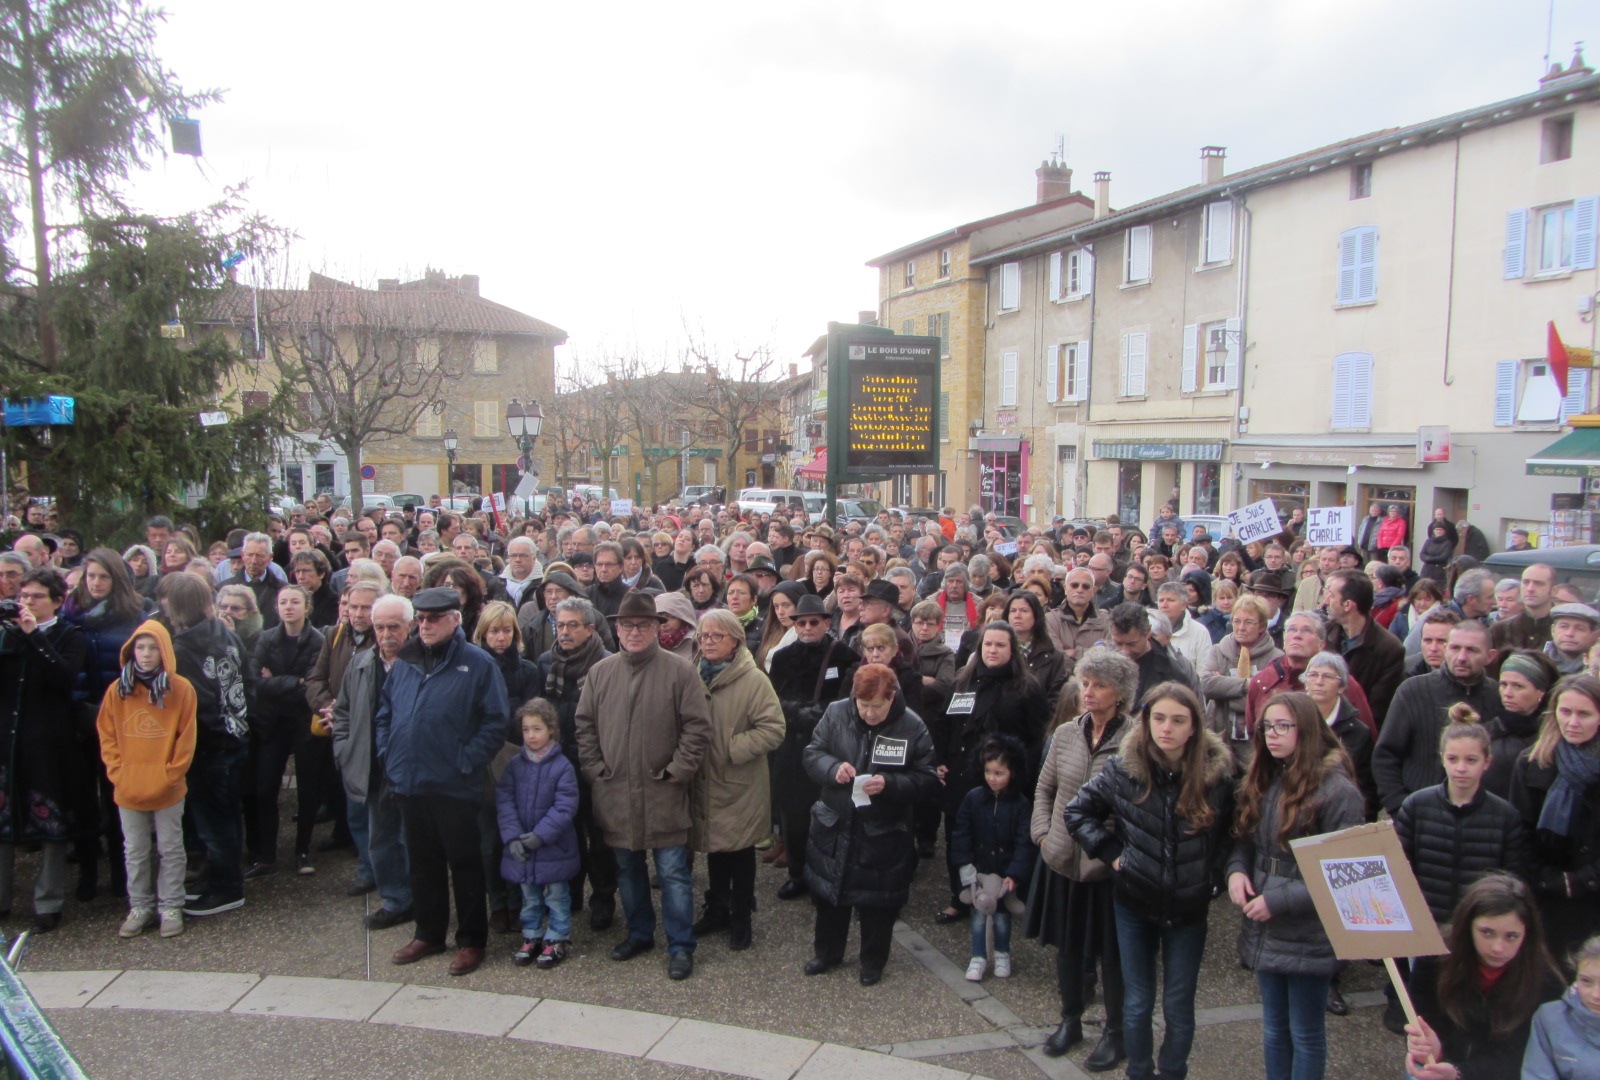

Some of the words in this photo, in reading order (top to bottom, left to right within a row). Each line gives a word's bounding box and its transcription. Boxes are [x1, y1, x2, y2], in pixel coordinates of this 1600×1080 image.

[867, 346, 878, 354] LE
[900, 347, 932, 355] D'OINGT
[1587, 465, 1600, 477] Ta
[1228, 512, 1242, 526] JE
[1310, 509, 1320, 527] I
[1327, 510, 1341, 525] AM
[876, 743, 886, 751] JE
[875, 749, 904, 757] CHARLIE
